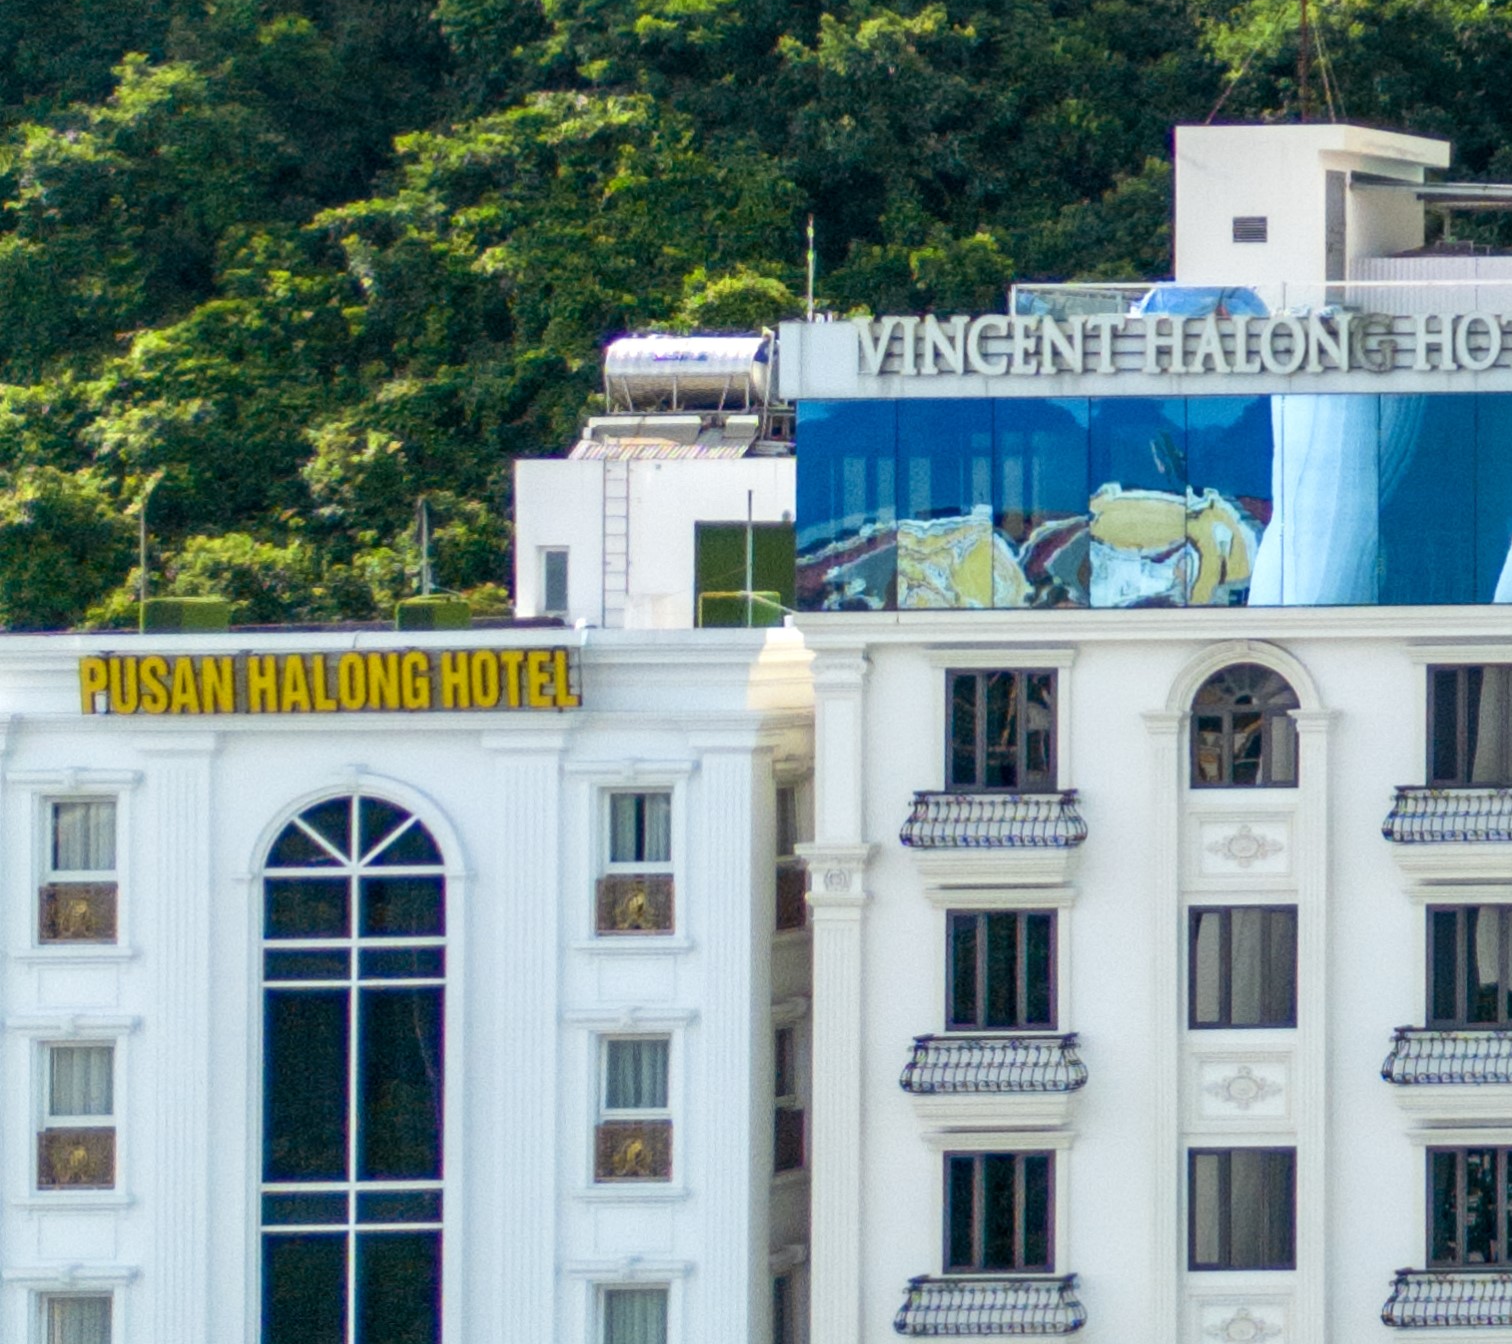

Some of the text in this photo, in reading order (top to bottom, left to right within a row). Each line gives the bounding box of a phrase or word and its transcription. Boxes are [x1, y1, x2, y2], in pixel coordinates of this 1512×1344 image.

[857, 313, 1127, 376] VINCENT
[1142, 312, 1398, 374] HALONG
[80, 648, 580, 715] PUSAN HALONG HOTEL
